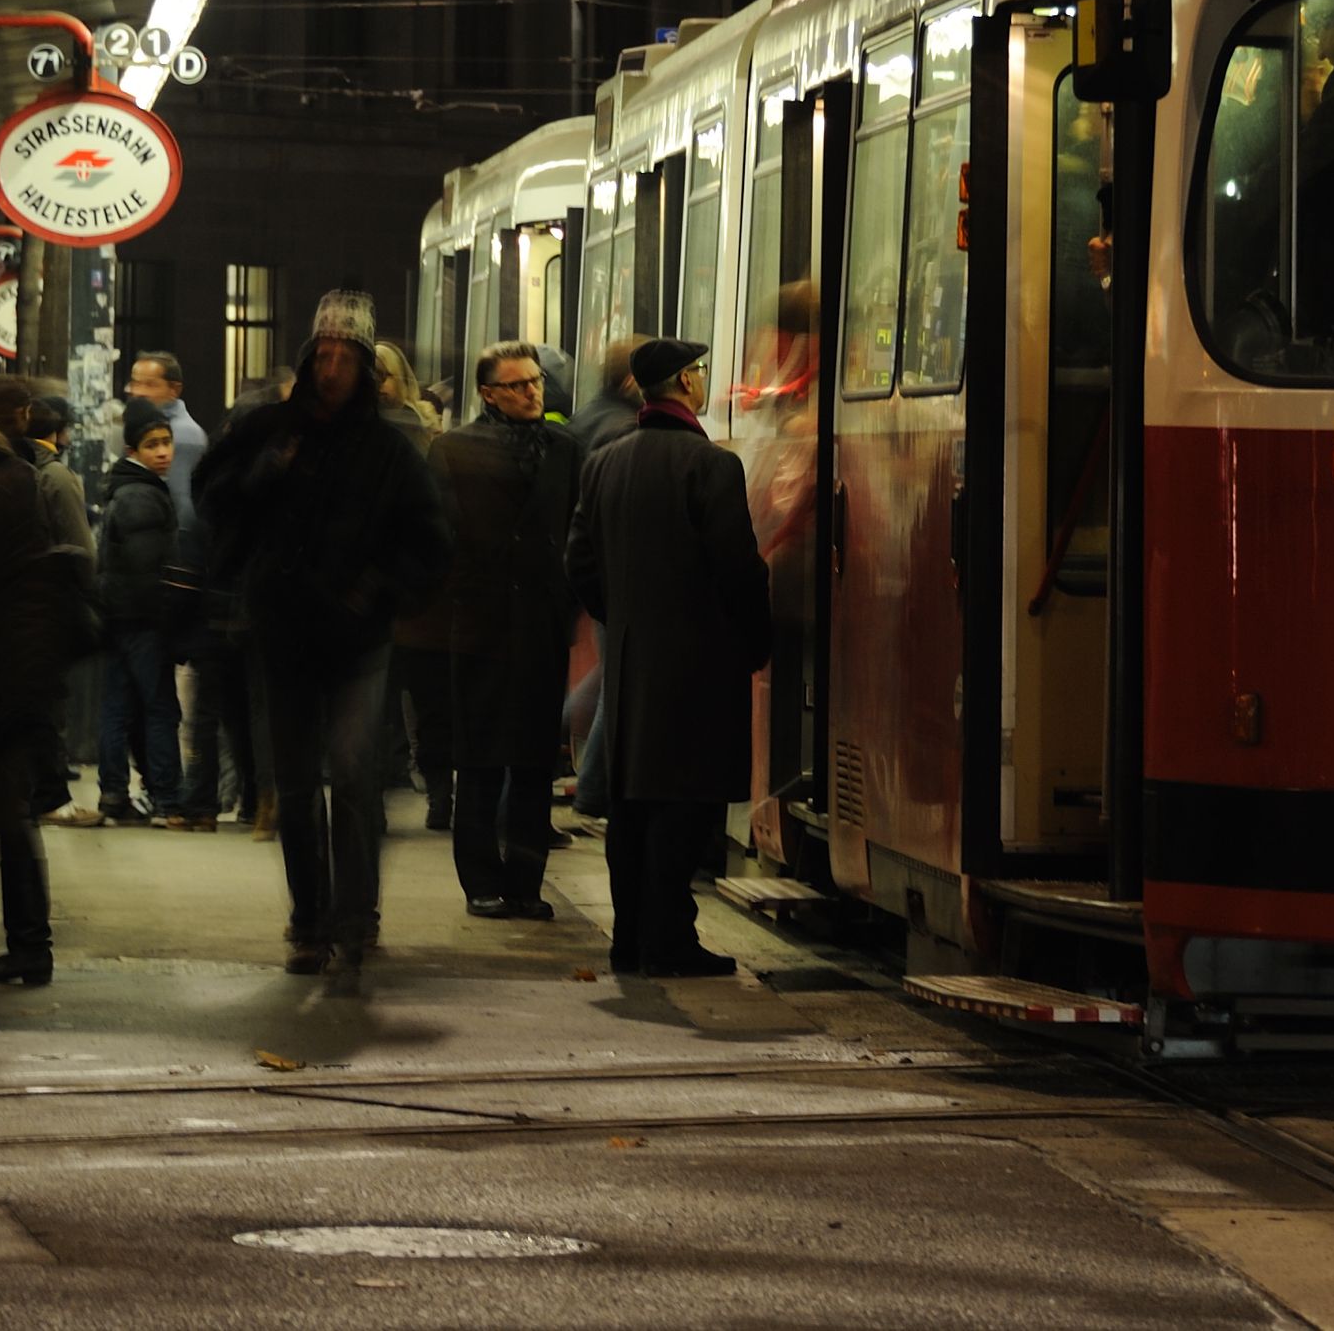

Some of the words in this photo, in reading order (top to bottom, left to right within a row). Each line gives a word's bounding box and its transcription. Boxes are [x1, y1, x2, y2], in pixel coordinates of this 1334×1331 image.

[110, 29, 131, 56] 2
[147, 30, 162, 56] 1
[32, 51, 61, 76] 71
[179, 52, 202, 78] D
[14, 115, 157, 166] STRASSENBAHN
[18, 183, 148, 228] HALTESTELLE
